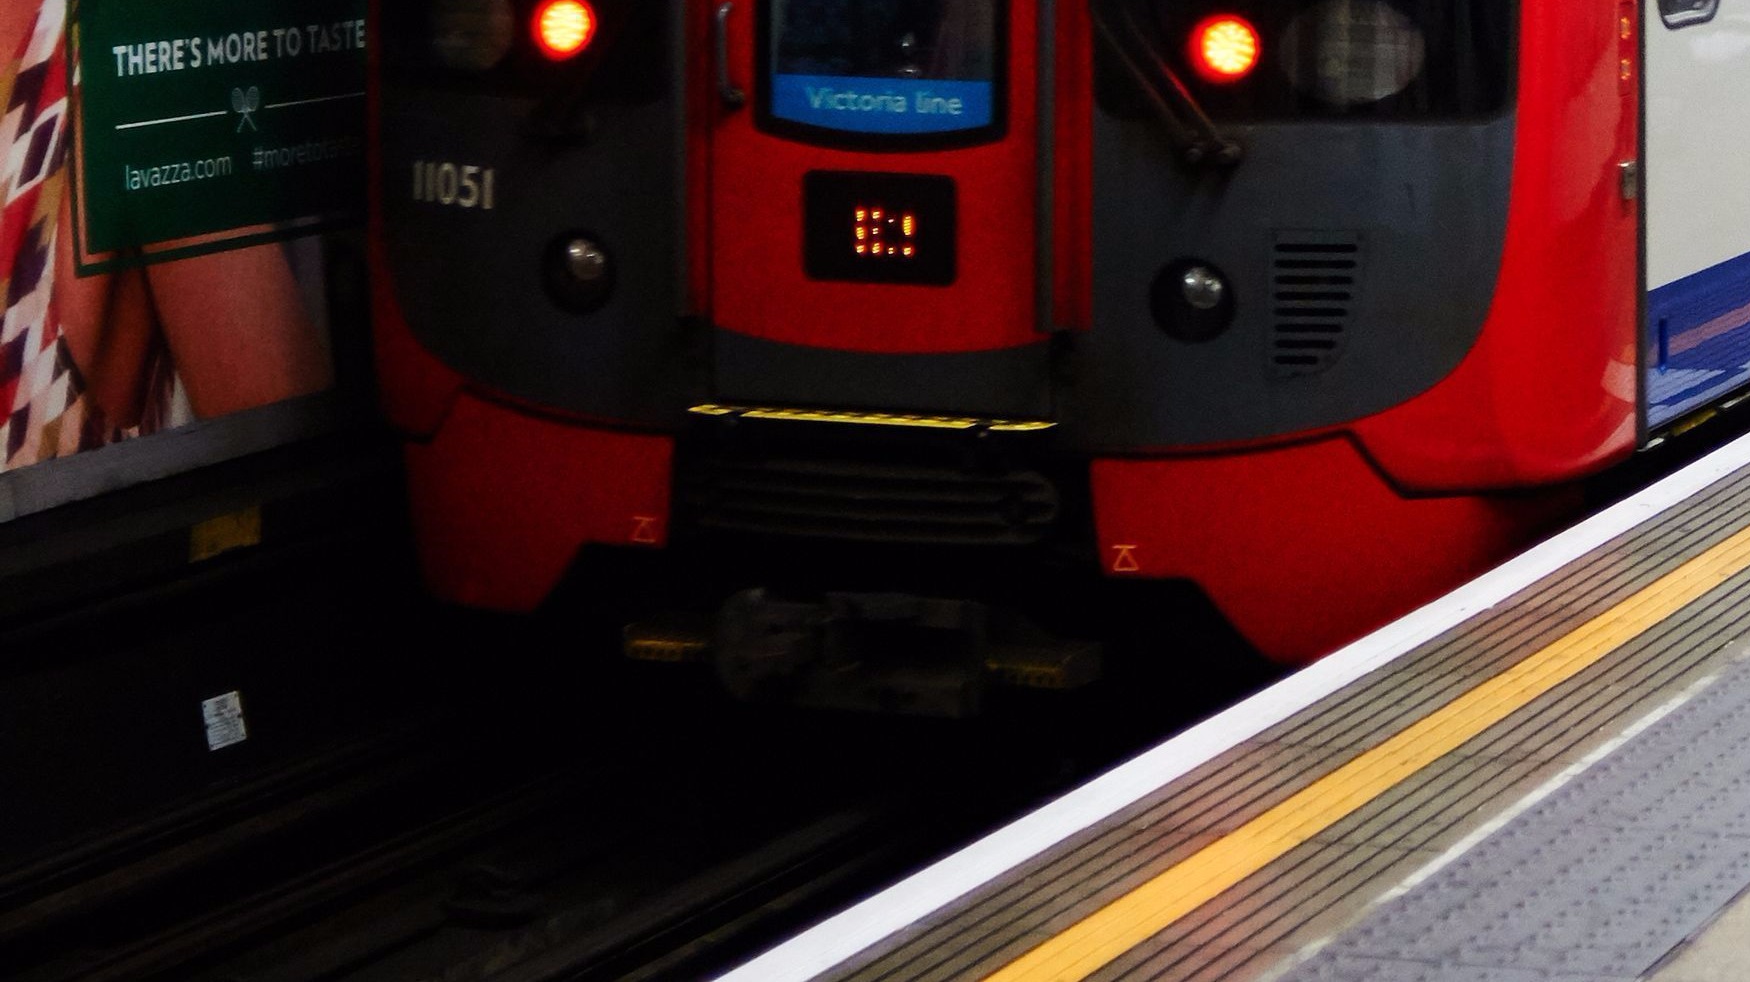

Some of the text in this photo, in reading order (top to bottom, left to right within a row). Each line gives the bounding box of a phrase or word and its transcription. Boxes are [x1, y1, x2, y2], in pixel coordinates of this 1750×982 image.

[112, 18, 366, 77] THERE'S MORE TO TASTE
[805, 85, 963, 116] Victoria line
[125, 155, 232, 191] lavazza.com
[413, 161, 496, 210] 11051
